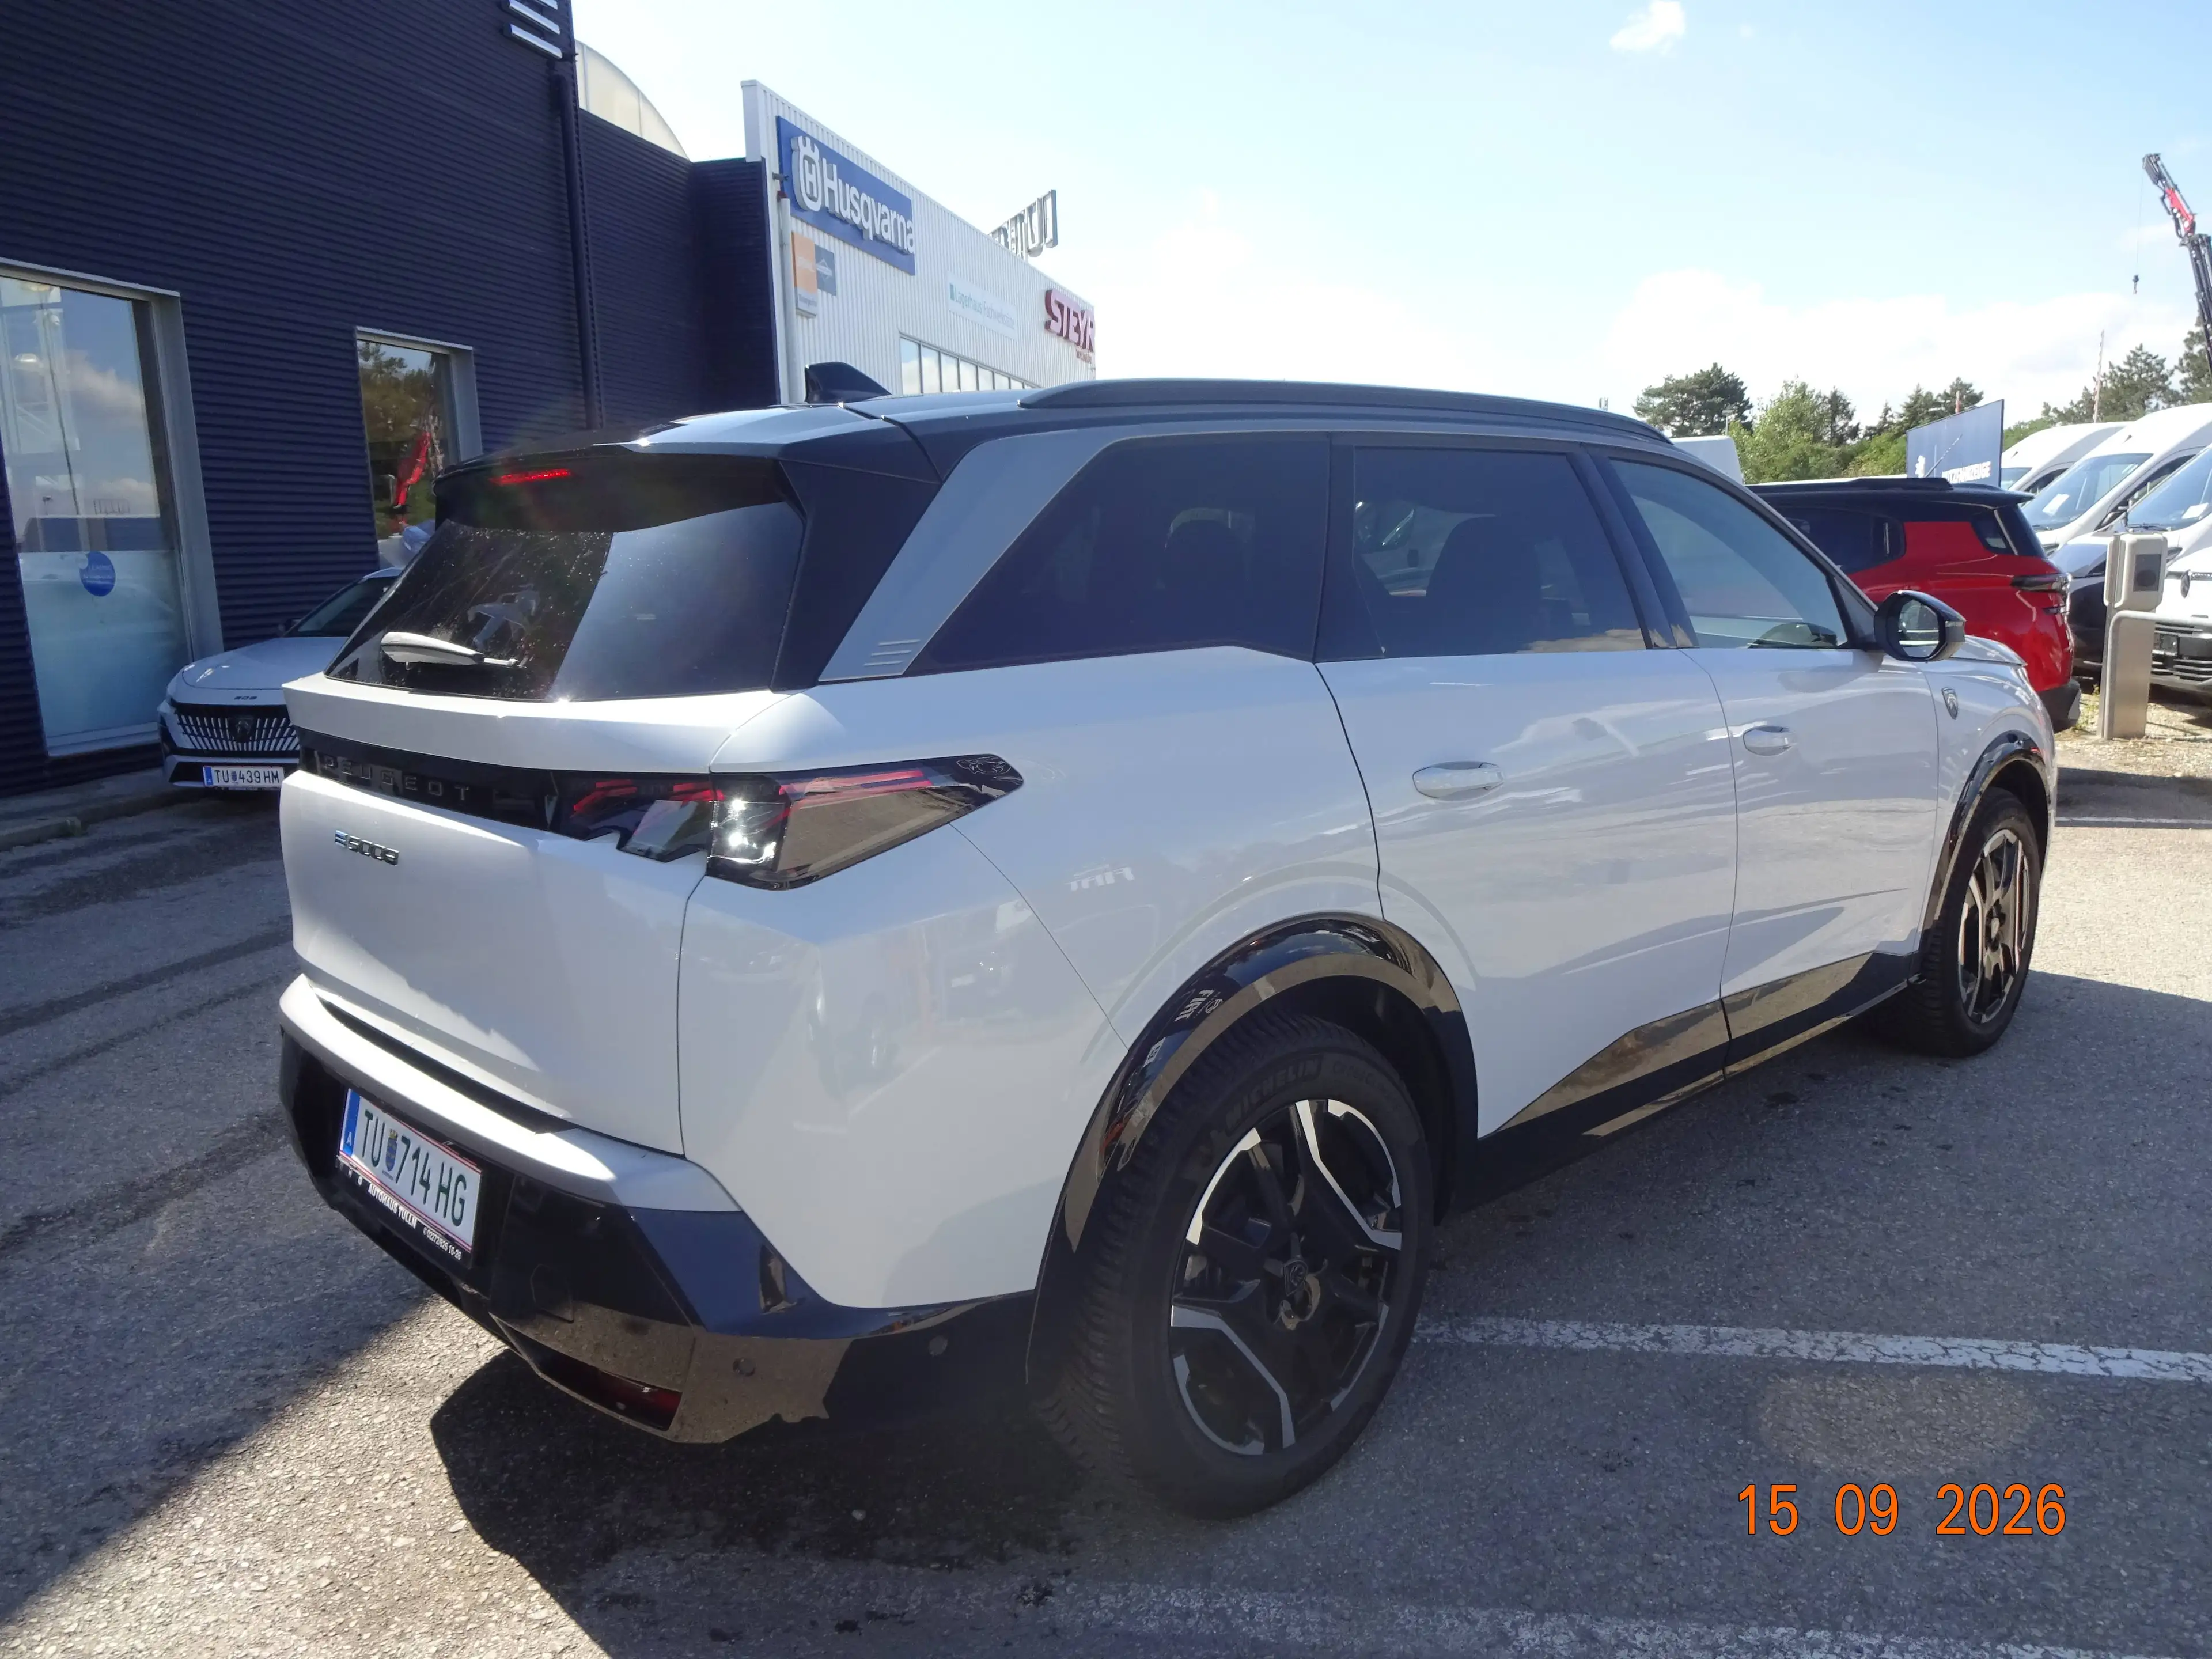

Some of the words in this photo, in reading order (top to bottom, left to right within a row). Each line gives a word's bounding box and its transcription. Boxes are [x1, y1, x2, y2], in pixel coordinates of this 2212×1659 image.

[822, 157, 915, 253] Husqvarna
[1046, 288, 1095, 353] STEYR
[214, 770, 229, 783] TU
[239, 770, 261, 783] 439
[264, 769, 280, 784] HM
[323, 754, 470, 801] PEUGEOT
[346, 1131, 353, 1145] A
[362, 1110, 385, 1168] TU
[395, 1135, 431, 1205] 714
[435, 1161, 467, 1227] HG
[368, 1183, 398, 1215] AUTOHAUS
[397, 1204, 418, 1229] TULLN
